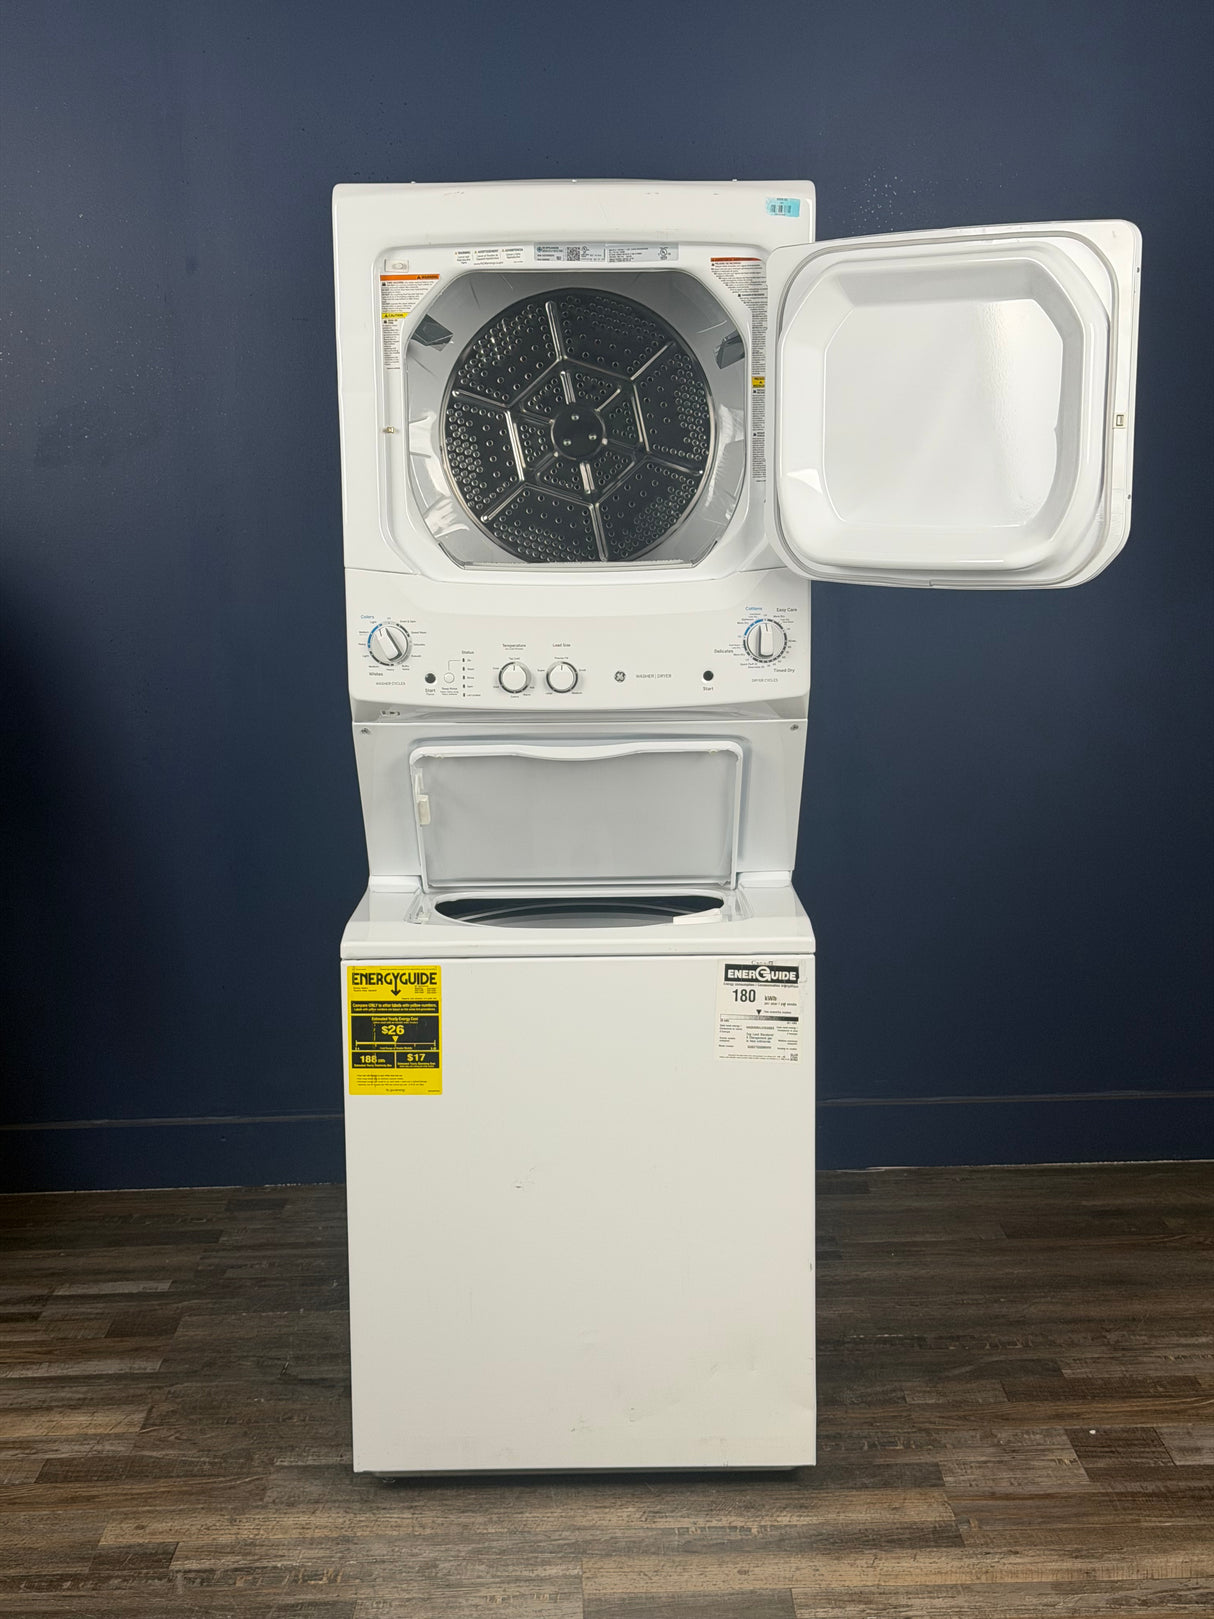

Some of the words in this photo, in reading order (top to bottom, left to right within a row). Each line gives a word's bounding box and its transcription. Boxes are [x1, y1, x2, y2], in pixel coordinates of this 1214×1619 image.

[352, 972, 437, 986] ENERGYGUIDE
[727, 965, 797, 982] ENERGUIDE
[732, 989, 756, 1003] 180
[381, 1024, 405, 1035] $26
[407, 1054, 426, 1062] $17
